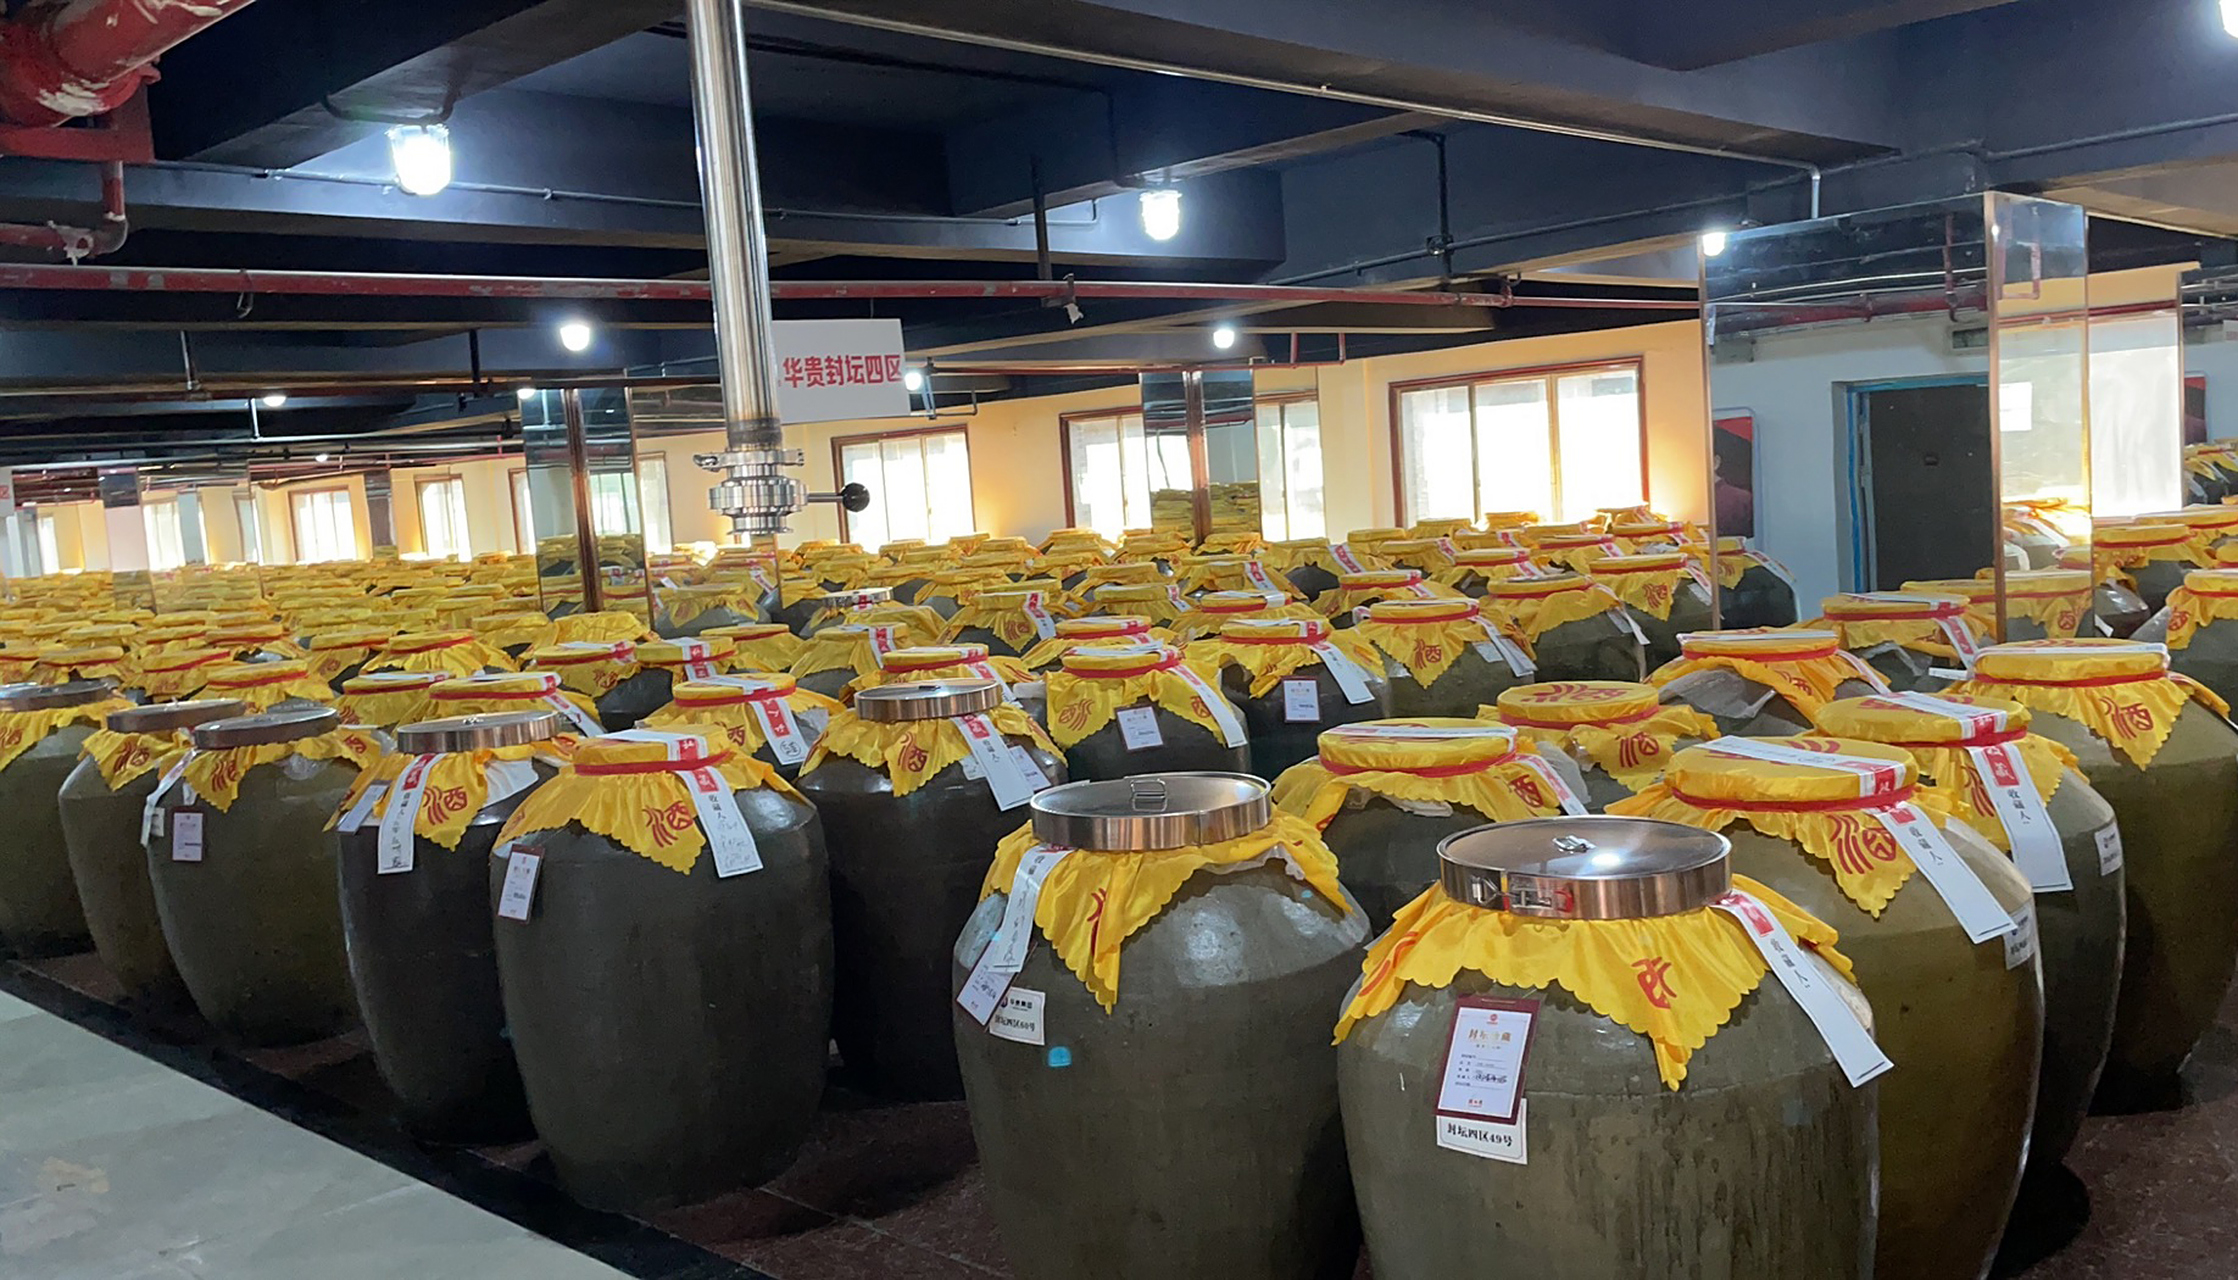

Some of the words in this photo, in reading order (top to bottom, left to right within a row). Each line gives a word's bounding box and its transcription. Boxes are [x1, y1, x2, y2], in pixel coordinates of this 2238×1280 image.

[783, 355, 902, 388] 华贵封坛四区
[1414, 638, 1442, 670] 酒
[2099, 696, 2153, 740] 酒
[899, 731, 929, 773] 酒
[423, 785, 468, 825] 酒
[642, 800, 693, 848] 酒
[1827, 814, 1897, 874] 酒
[1447, 1122, 1514, 1147] 封坛四区49号
